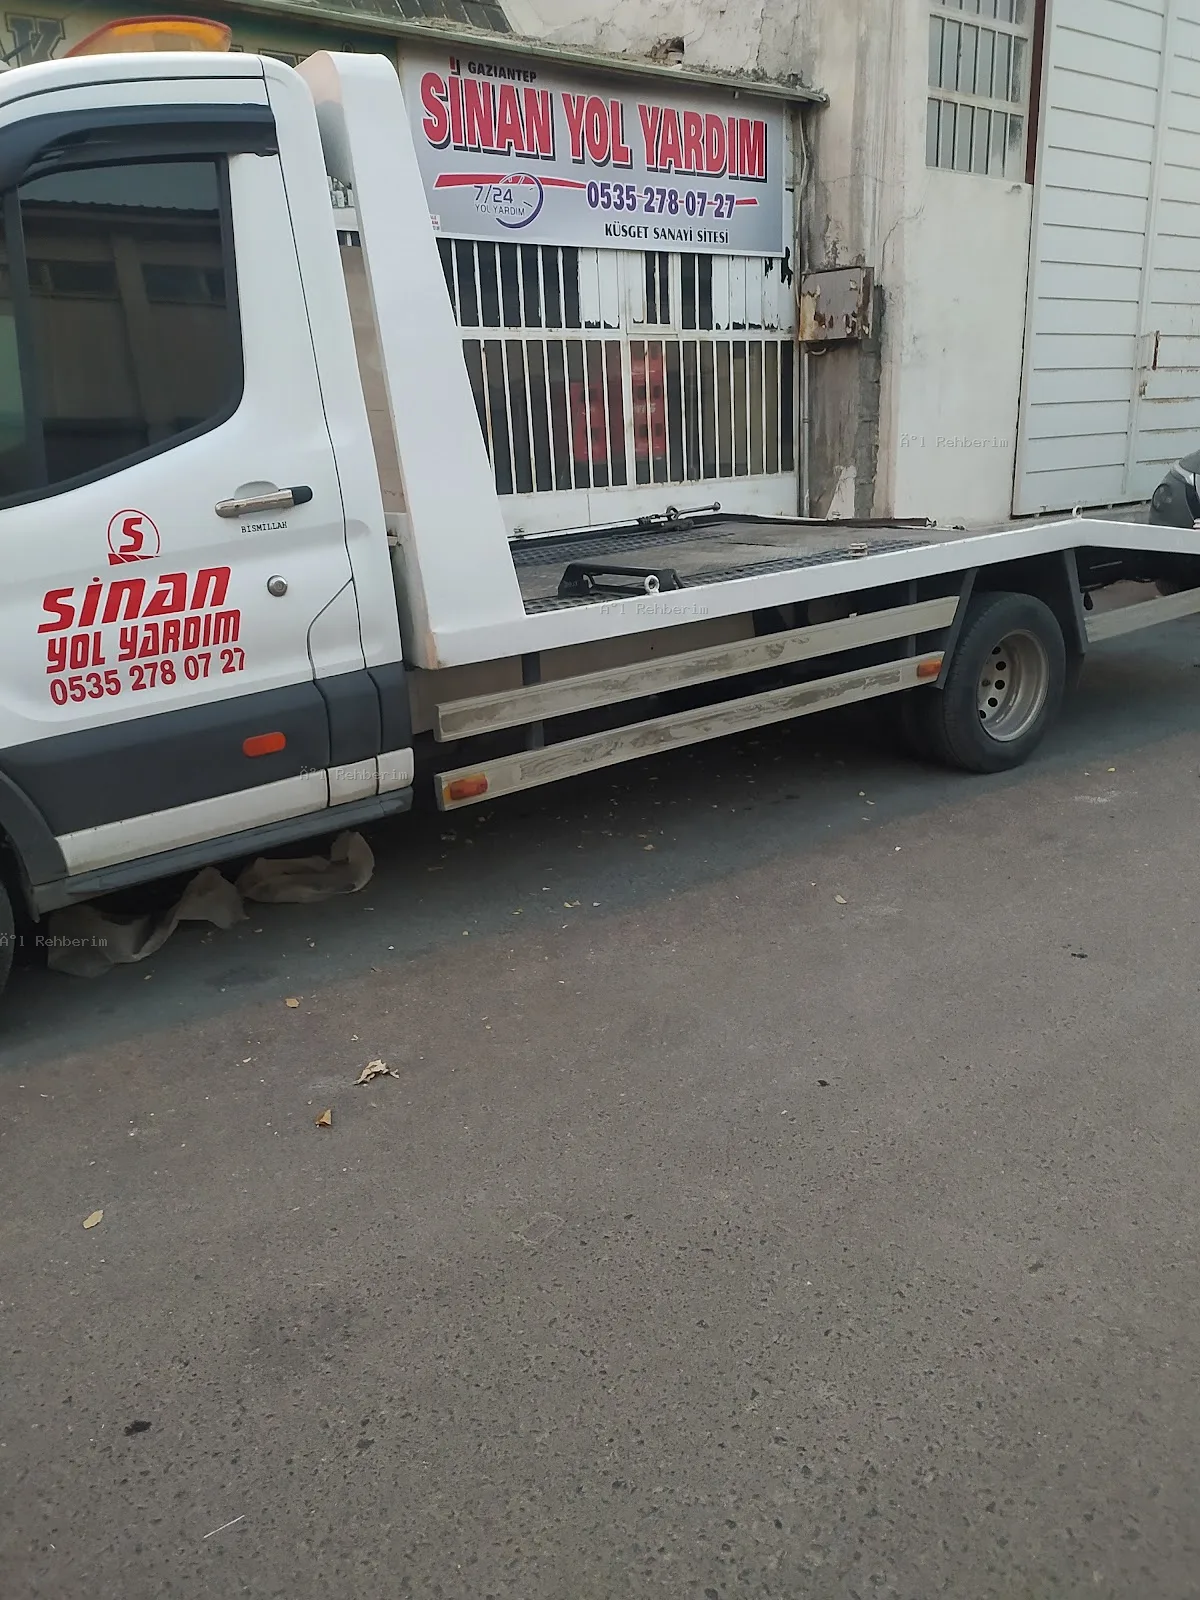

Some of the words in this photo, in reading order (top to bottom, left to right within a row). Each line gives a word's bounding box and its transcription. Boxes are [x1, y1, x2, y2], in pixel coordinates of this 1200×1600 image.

[468, 61, 537, 83] GAZIANTEP
[421, 56, 556, 162] SİNAN
[561, 92, 633, 169] YOL
[636, 103, 768, 183] YARDIM
[474, 184, 513, 204] 7/24
[587, 181, 637, 211] 0535
[643, 186, 679, 215] 278
[685, 191, 707, 217] 07
[714, 193, 735, 219] 27
[475, 203, 491, 214] YOL
[493, 206, 526, 216] YARDIM
[604, 221, 649, 240] KÜSGET
[653, 226, 693, 242] SANAYİ
[697, 227, 729, 244] SİTESİ
[46, 629, 106, 675] YOL
[49, 668, 122, 706] 0535
[131, 659, 177, 692] 278
[183, 651, 212, 682] 07
[219, 647, 246, 674] 27
